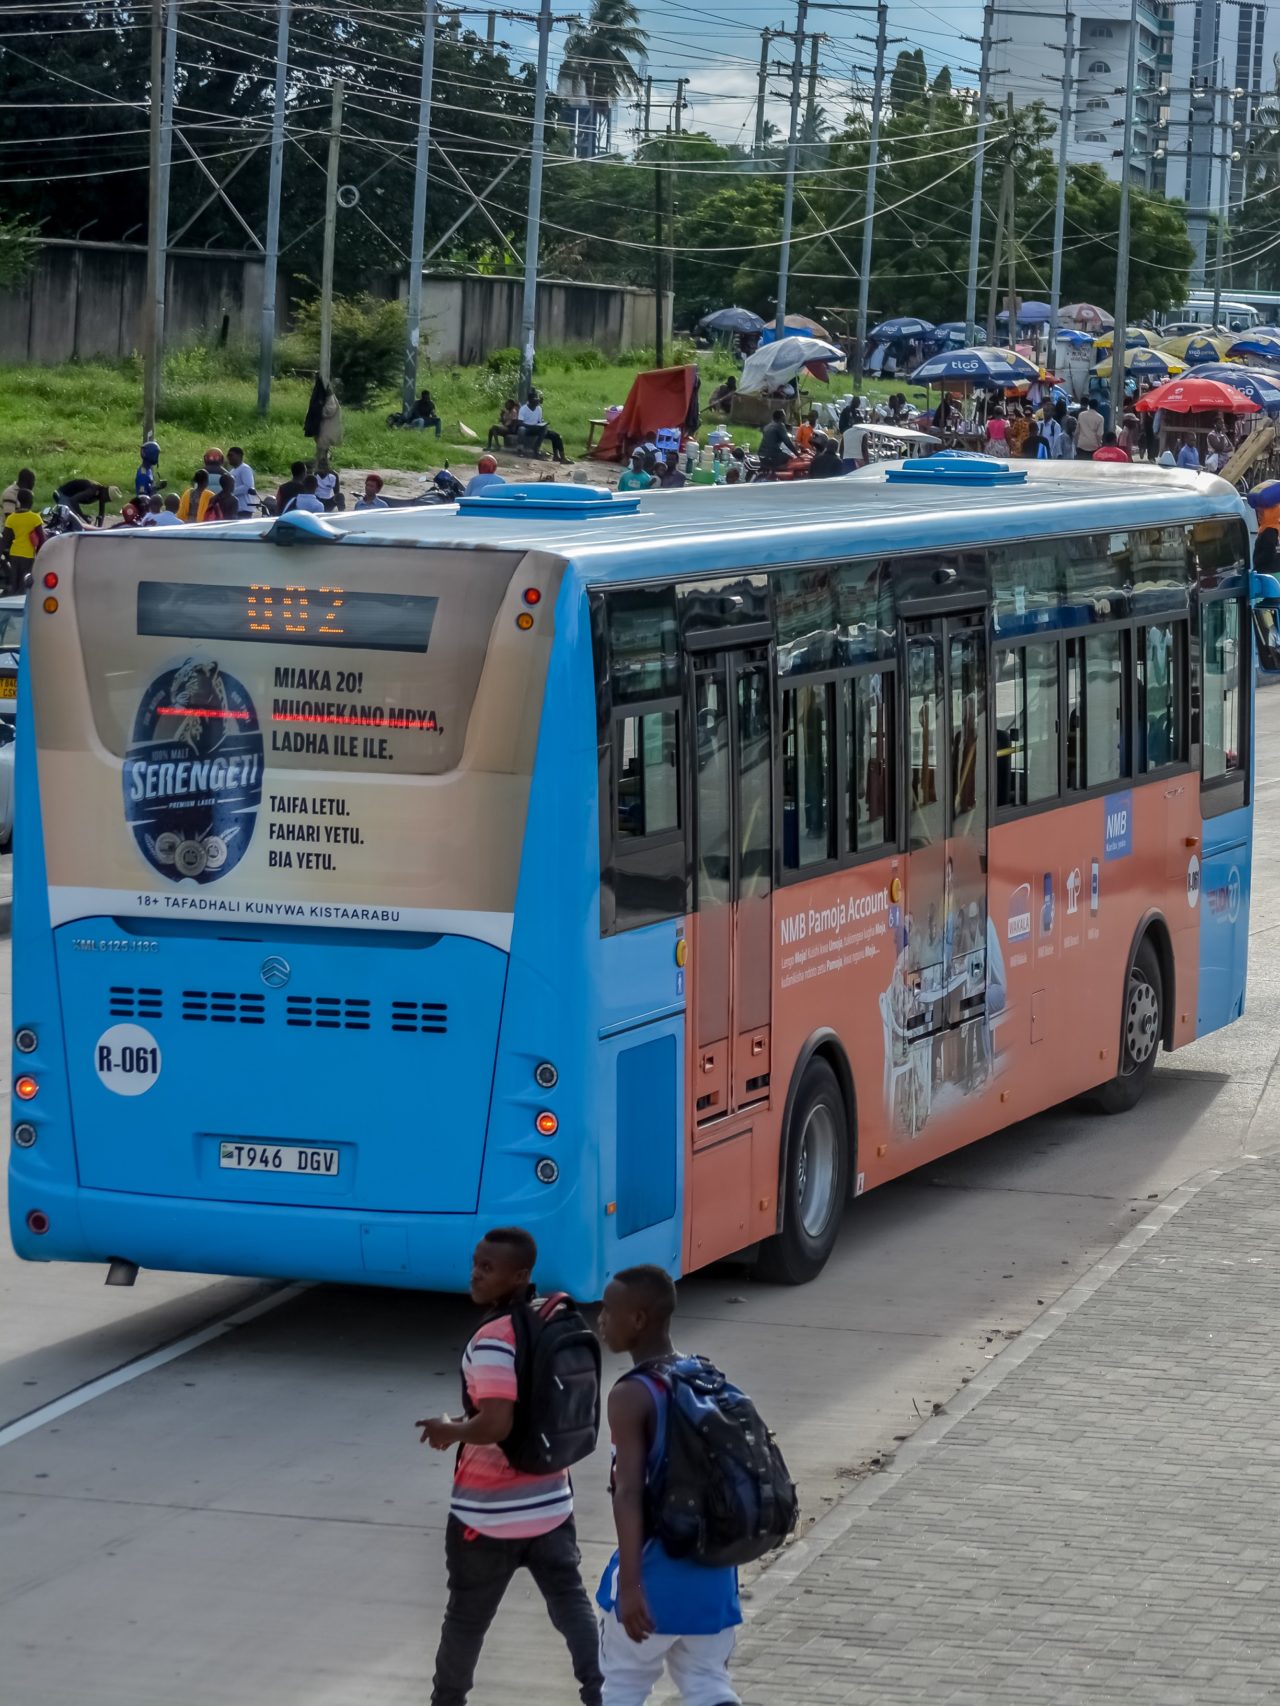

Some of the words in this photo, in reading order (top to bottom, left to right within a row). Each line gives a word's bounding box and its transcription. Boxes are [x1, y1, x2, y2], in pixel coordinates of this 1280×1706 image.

[951, 359, 979, 371] tigo
[273, 666, 332, 692] MIAKA
[335, 671, 364, 694] 20!
[272, 698, 387, 727] MUONEKANO
[272, 730, 329, 756] LADHA
[333, 734, 359, 758] ILE
[363, 737, 394, 760] ILE.
[131, 754, 258, 801] SERENGETI
[269, 795, 309, 815] TAIFA
[312, 797, 351, 817] LETU.
[269, 822, 321, 843] FAHARI
[324, 825, 365, 845] YETU.
[1107, 810, 1127, 840] NMB
[268, 850, 293, 868] BIA
[297, 852, 337, 871] YETU.
[136, 895, 160, 907] 18+
[164, 896, 240, 912] TAFADHALI
[245, 902, 305, 918] KUNYWA
[310, 905, 400, 923] KISTAARABU
[781, 912, 807, 946] NMB
[808, 897, 847, 936] Pamoja
[847, 887, 889, 923] Account
[98, 1046, 158, 1074] R-061
[234, 1146, 283, 1169] T946
[297, 1150, 335, 1172] DGV
